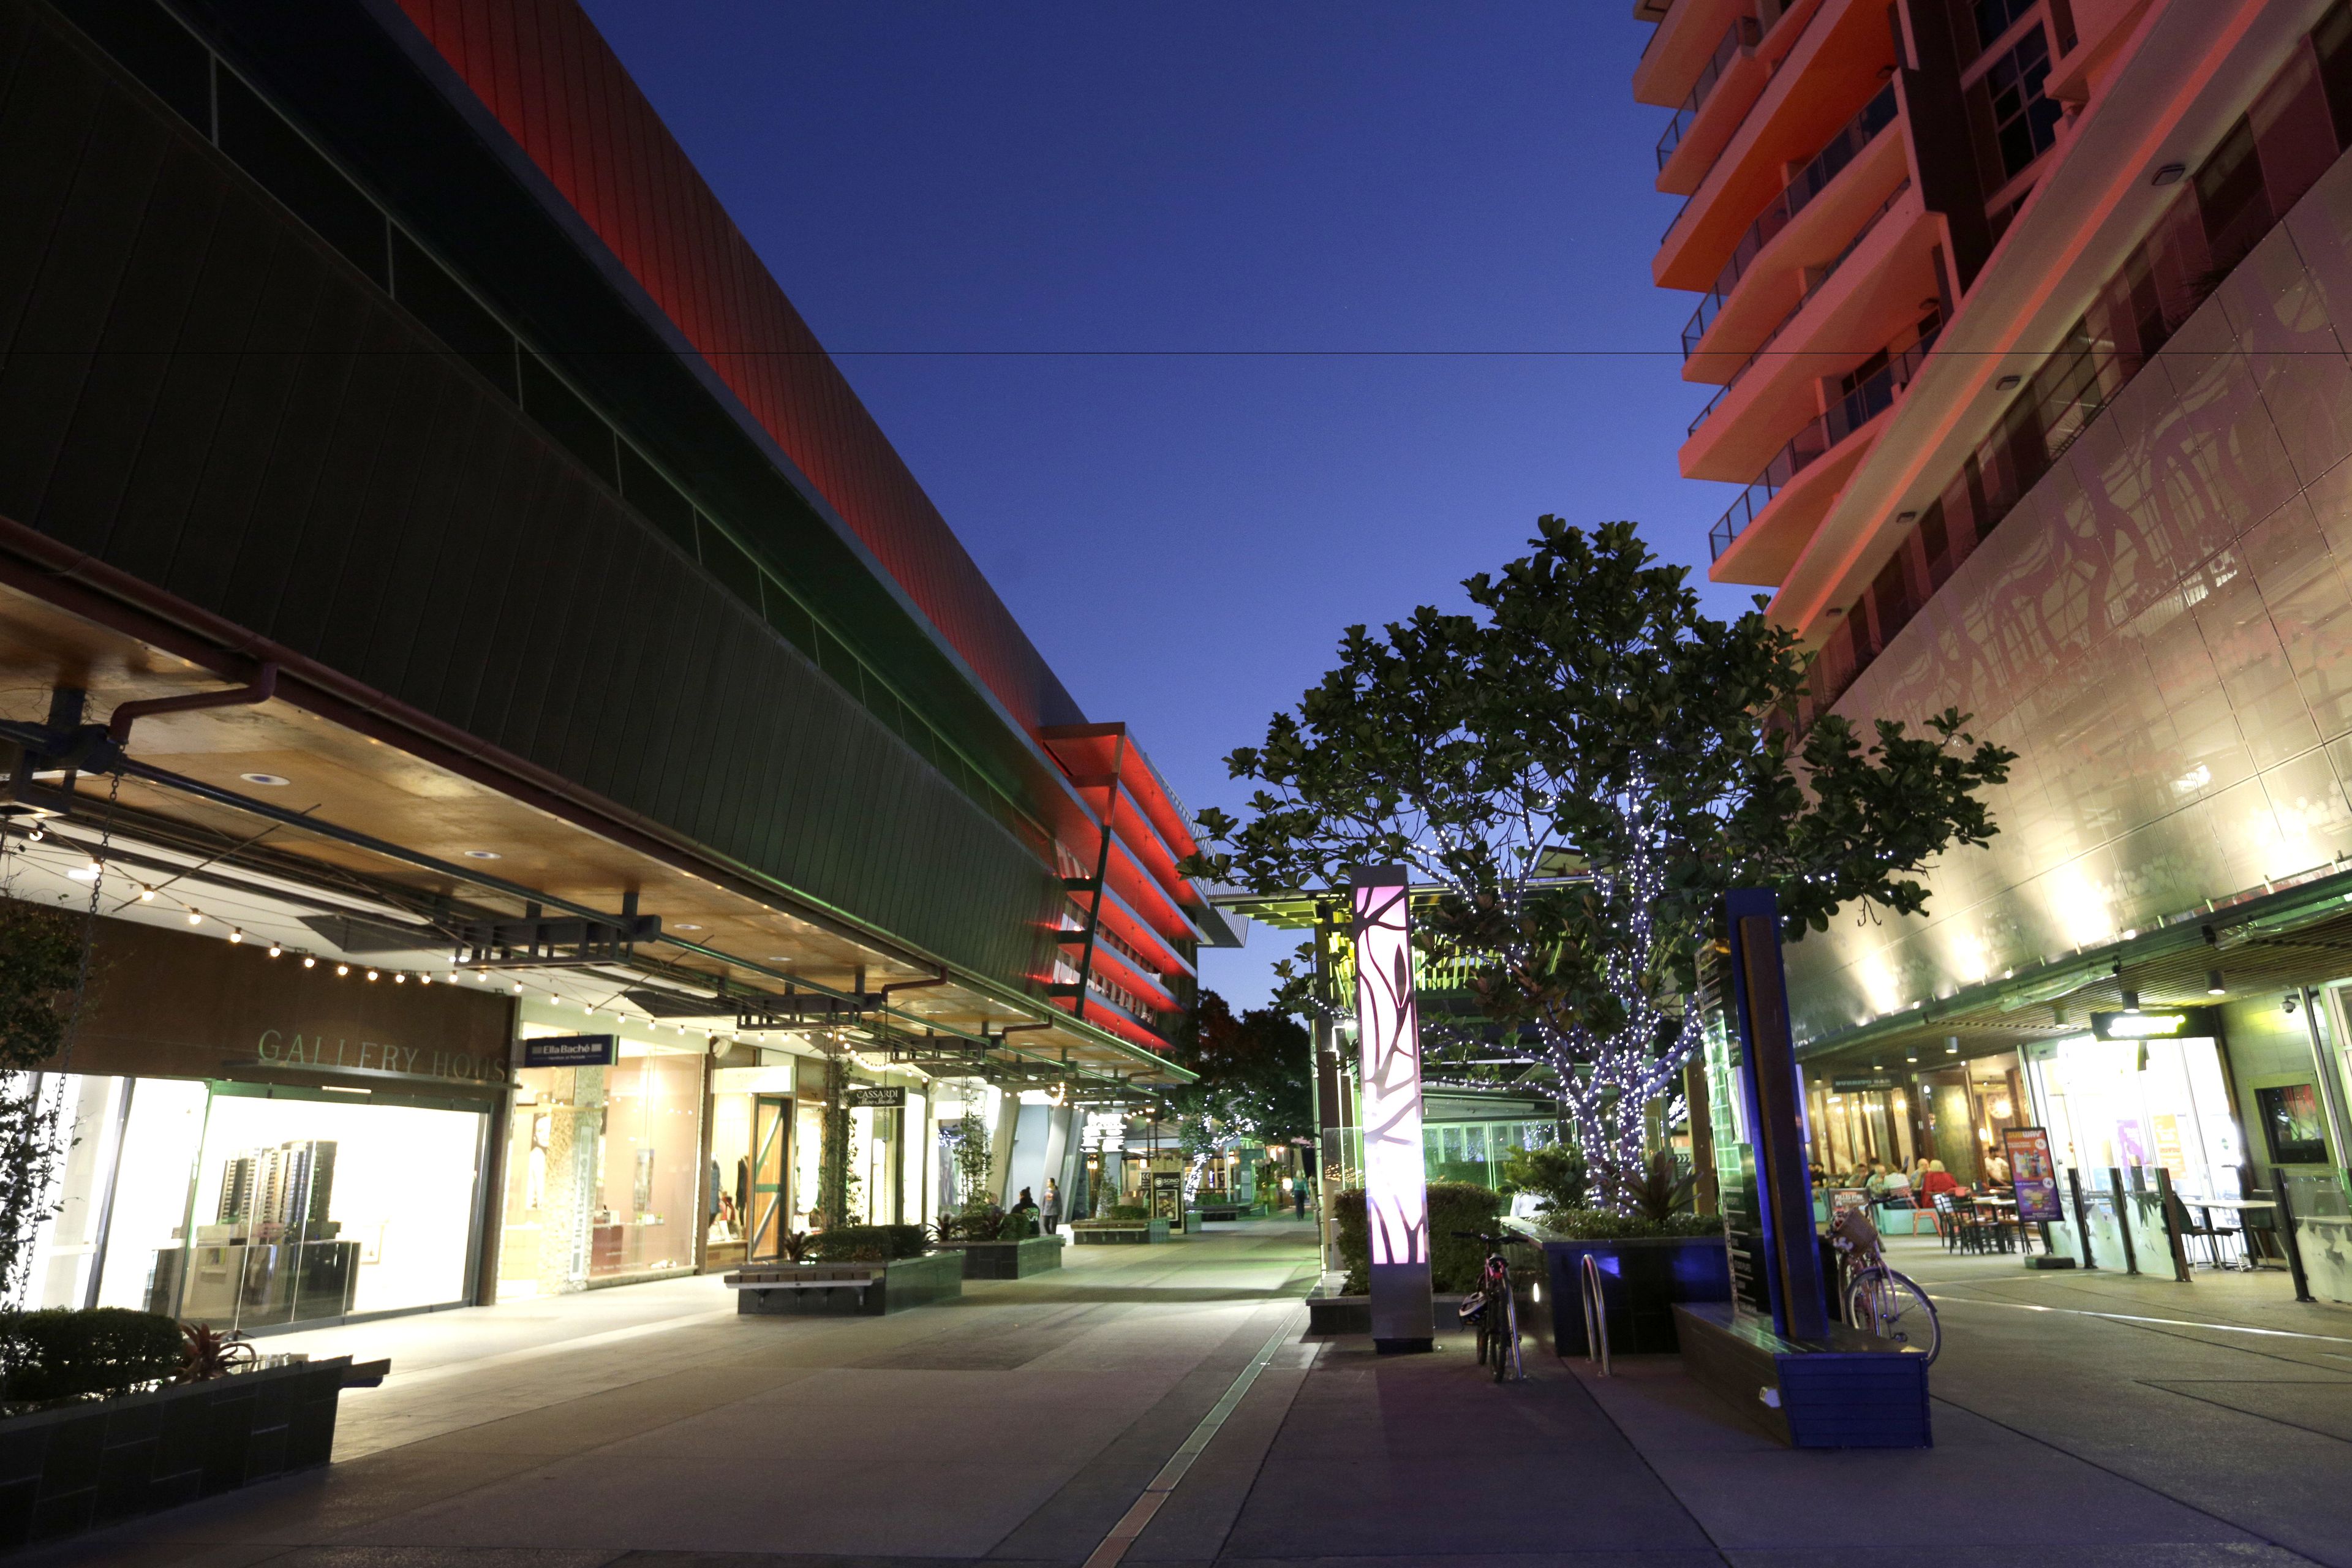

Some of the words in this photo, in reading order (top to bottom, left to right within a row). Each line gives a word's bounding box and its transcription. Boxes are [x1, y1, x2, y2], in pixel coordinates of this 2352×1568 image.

[258, 1029, 420, 1074] GALLERY
[432, 1050, 506, 1083] HOUS
[543, 1045, 560, 1054] Ella
[561, 1044, 590, 1054] Baché
[857, 1090, 898, 1098] CASSARDI
[574, 1218, 583, 1250] Ella
